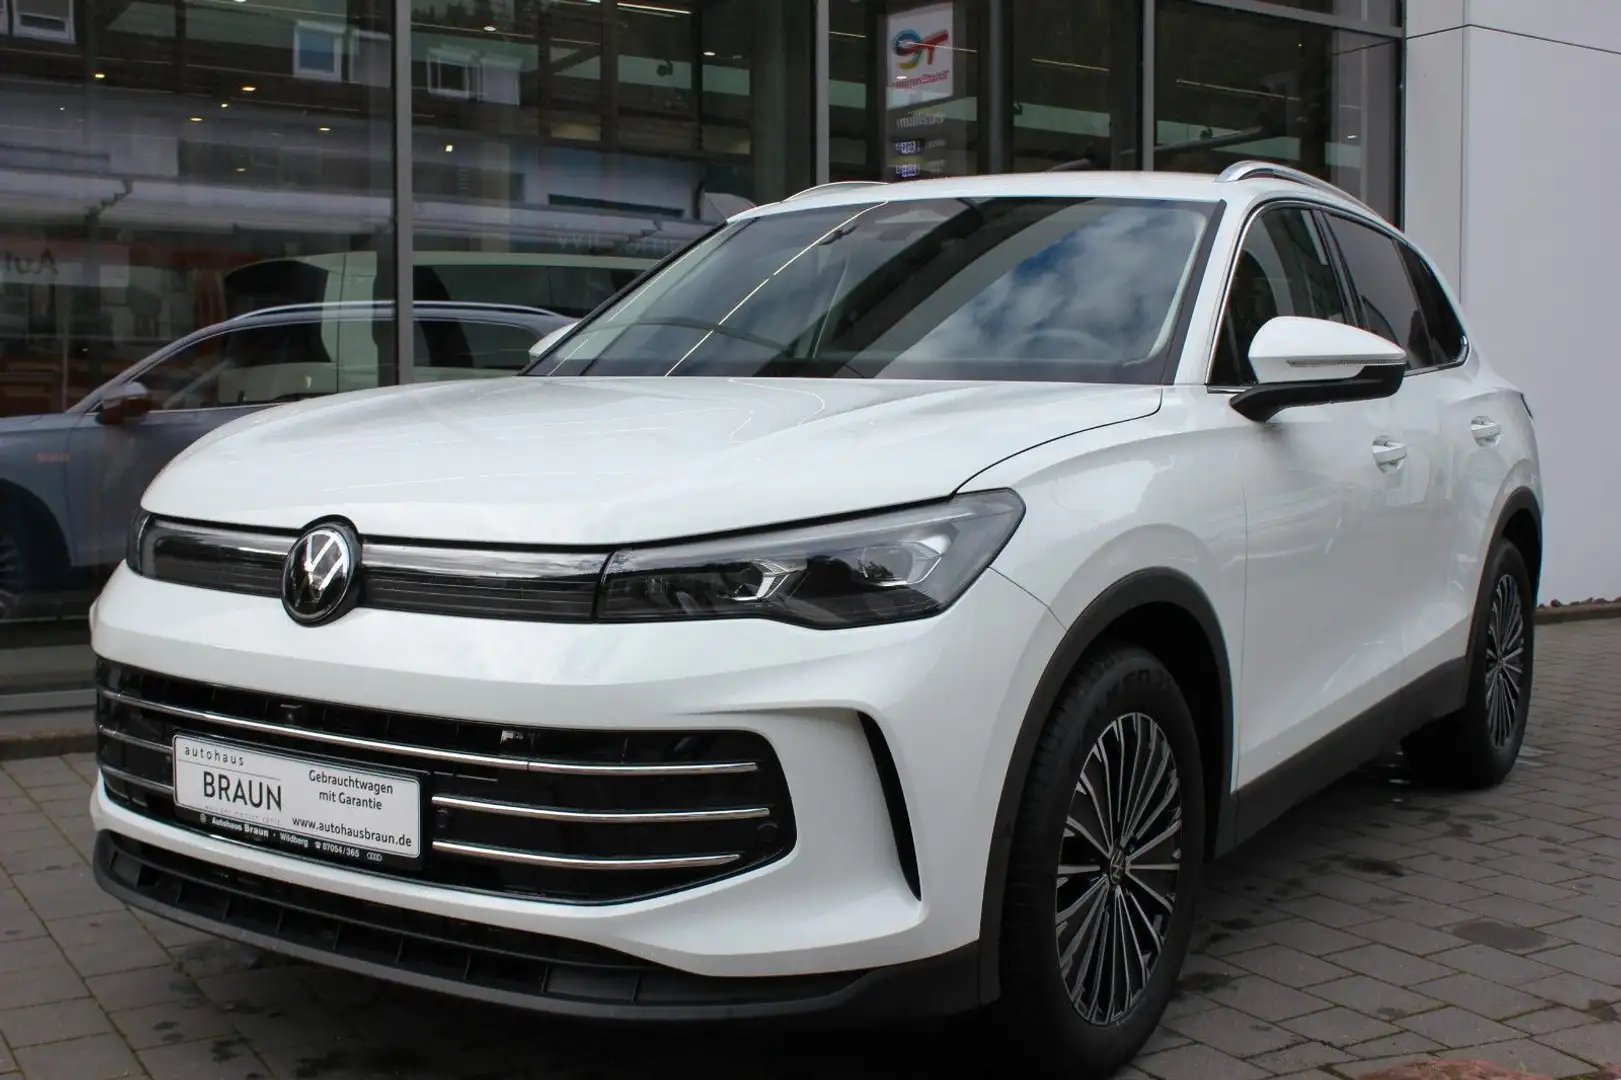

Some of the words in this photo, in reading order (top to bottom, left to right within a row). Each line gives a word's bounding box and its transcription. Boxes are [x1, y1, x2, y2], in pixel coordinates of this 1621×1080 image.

[184, 746, 244, 766] autohaus
[203, 770, 282, 812] BRAUN
[308, 769, 394, 795] Gebrauchtwagen
[319, 790, 337, 803] mit
[338, 792, 383, 810] Garantie
[244, 823, 269, 837] Braun
[279, 832, 309, 848] Wildberg
[292, 817, 413, 847] www.autohausbraun.de
